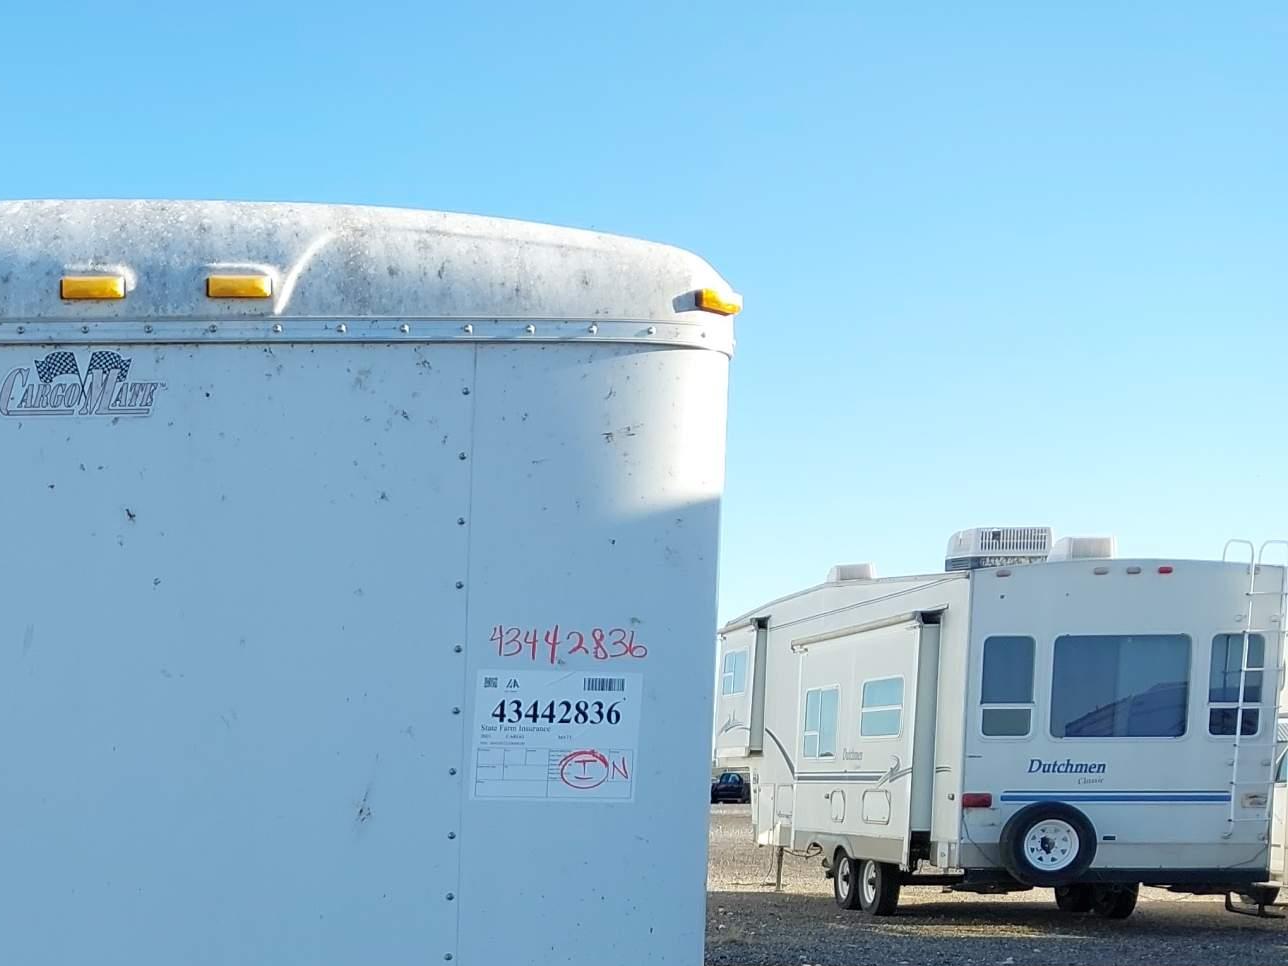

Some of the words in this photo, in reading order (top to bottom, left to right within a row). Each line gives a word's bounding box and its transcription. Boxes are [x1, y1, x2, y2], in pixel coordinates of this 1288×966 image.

[489, 625, 648, 664] 43442836
[491, 699, 622, 725] 43442836
[480, 724, 498, 732] State
[499, 724, 517, 732] Farm
[518, 724, 552, 733] Insurance
[1027, 758, 1107, 774] Dutchmen
